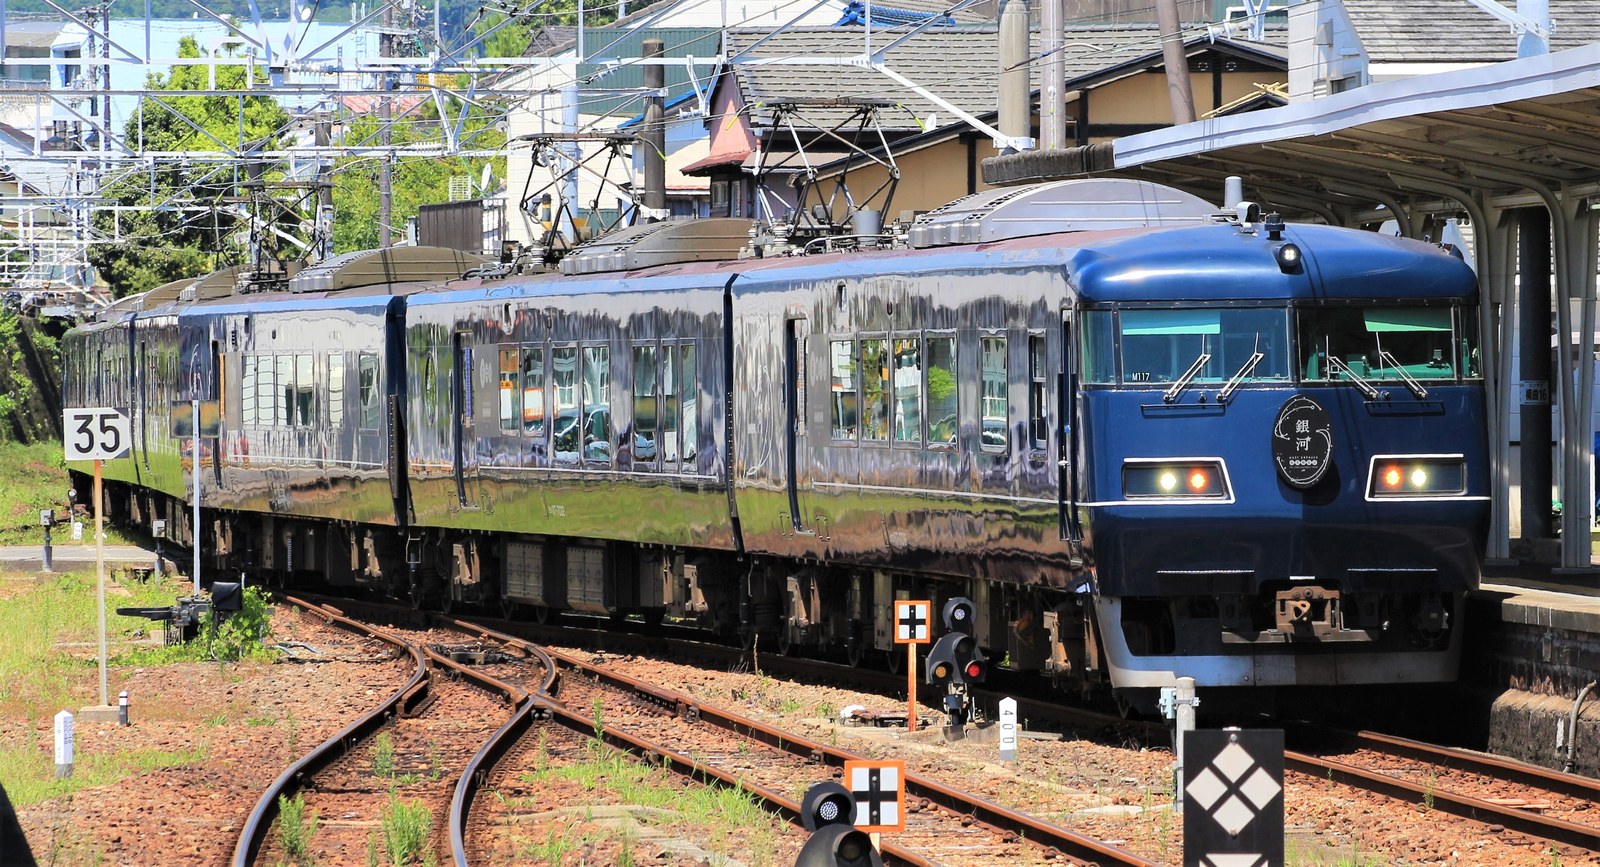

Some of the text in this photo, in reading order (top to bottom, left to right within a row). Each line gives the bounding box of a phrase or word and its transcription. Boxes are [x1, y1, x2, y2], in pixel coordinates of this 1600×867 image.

[1132, 372, 1150, 381] M117
[73, 413, 120, 453] 35
[1295, 419, 1311, 451] 銀河
[1002, 709, 1015, 744] 400
